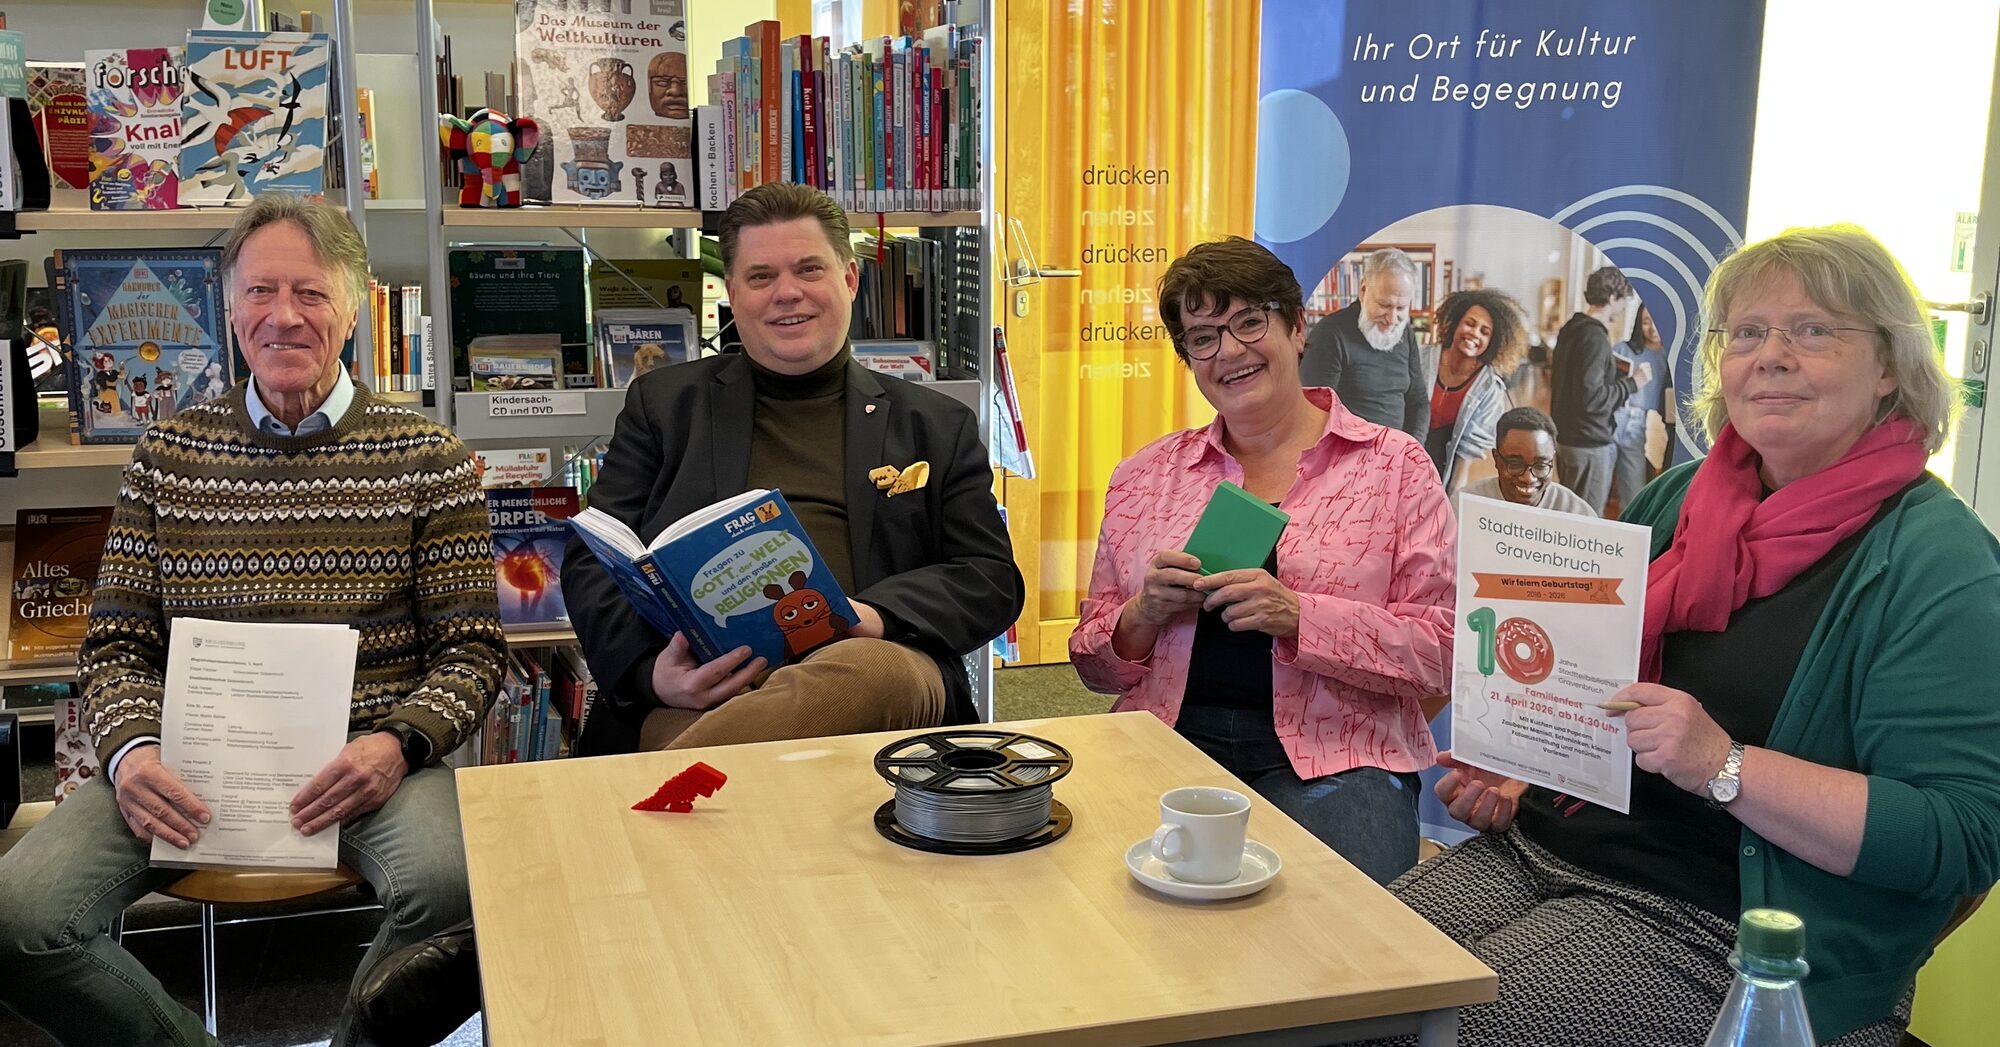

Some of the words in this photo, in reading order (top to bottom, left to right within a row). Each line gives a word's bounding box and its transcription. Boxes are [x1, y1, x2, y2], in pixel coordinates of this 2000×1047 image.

[539, 14, 566, 26] Das
[571, 16, 634, 30] Museum
[637, 20, 661, 31] der
[536, 27, 663, 47] Weltkulturen
[1353, 33, 1394, 61] Ihr
[1408, 33, 1461, 60] Ort
[1475, 29, 1522, 58] für
[1535, 26, 1637, 57] Kultur
[224, 49, 292, 71] LUFT
[803, 88, 812, 111] Koch
[1361, 73, 1419, 103] und
[1431, 75, 1622, 110] Begegnung
[804, 113, 813, 133] mal!
[1082, 164, 1170, 185] drücken
[709, 170, 718, 208] Kochen
[1081, 243, 1168, 264] drücken
[107, 303, 179, 320] MAGISCHEN
[88, 319, 203, 346] EXPERIMENTE
[425, 323, 434, 361] Sachbuch
[629, 328, 662, 339] BÄREN
[1080, 322, 1167, 342] drücken
[492, 395, 551, 404] Kindersach-
[493, 407, 507, 415] CD
[510, 407, 528, 415] und
[532, 406, 553, 414] DVD
[487, 500, 499, 508] ER
[502, 497, 567, 507] MENSCHLICHE
[489, 509, 548, 526] ÖRPER
[724, 512, 756, 534] FRAG
[1479, 516, 1625, 557] Stadtteilbibliothek
[739, 561, 753, 574] der
[749, 529, 793, 562] WELT
[1495, 541, 1601, 575] Gravenbruch
[22, 560, 70, 579] Altes
[702, 556, 734, 578] Fragen
[734, 549, 745, 559] zu
[714, 549, 810, 615] RELIGIONEN
[721, 583, 736, 596] und
[737, 574, 752, 585] den
[751, 557, 778, 576] großen
[1501, 578, 1515, 586] Wir
[1516, 578, 1541, 588] feiern
[1541, 580, 1593, 591] Geburtstag!
[1467, 606, 1554, 685] 10
[1558, 658, 1578, 669] Jahre
[1558, 667, 1619, 689] Stadtteilbibliothek
[1558, 677, 1604, 695] Gravenbruch
[1525, 687, 1583, 709] Familienfest
[1490, 691, 1502, 701] 21.
[1504, 695, 1528, 711] April
[1558, 709, 1571, 721] ab
[1573, 712, 1600, 729] 14:30
[1602, 720, 1620, 735] Uhr
[1519, 715, 1528, 723] Mit
[1530, 718, 1552, 729] Kuchen
[1554, 723, 1566, 733] und
[1502, 719, 1529, 732] Zauberer
[1591, 743, 1612, 755] kleiner
[1512, 729, 1560, 749] Fotoausstellung
[1561, 742, 1573, 752] und
[1574, 746, 1601, 761] natürlich
[1543, 747, 1570, 759] Vorlesen
